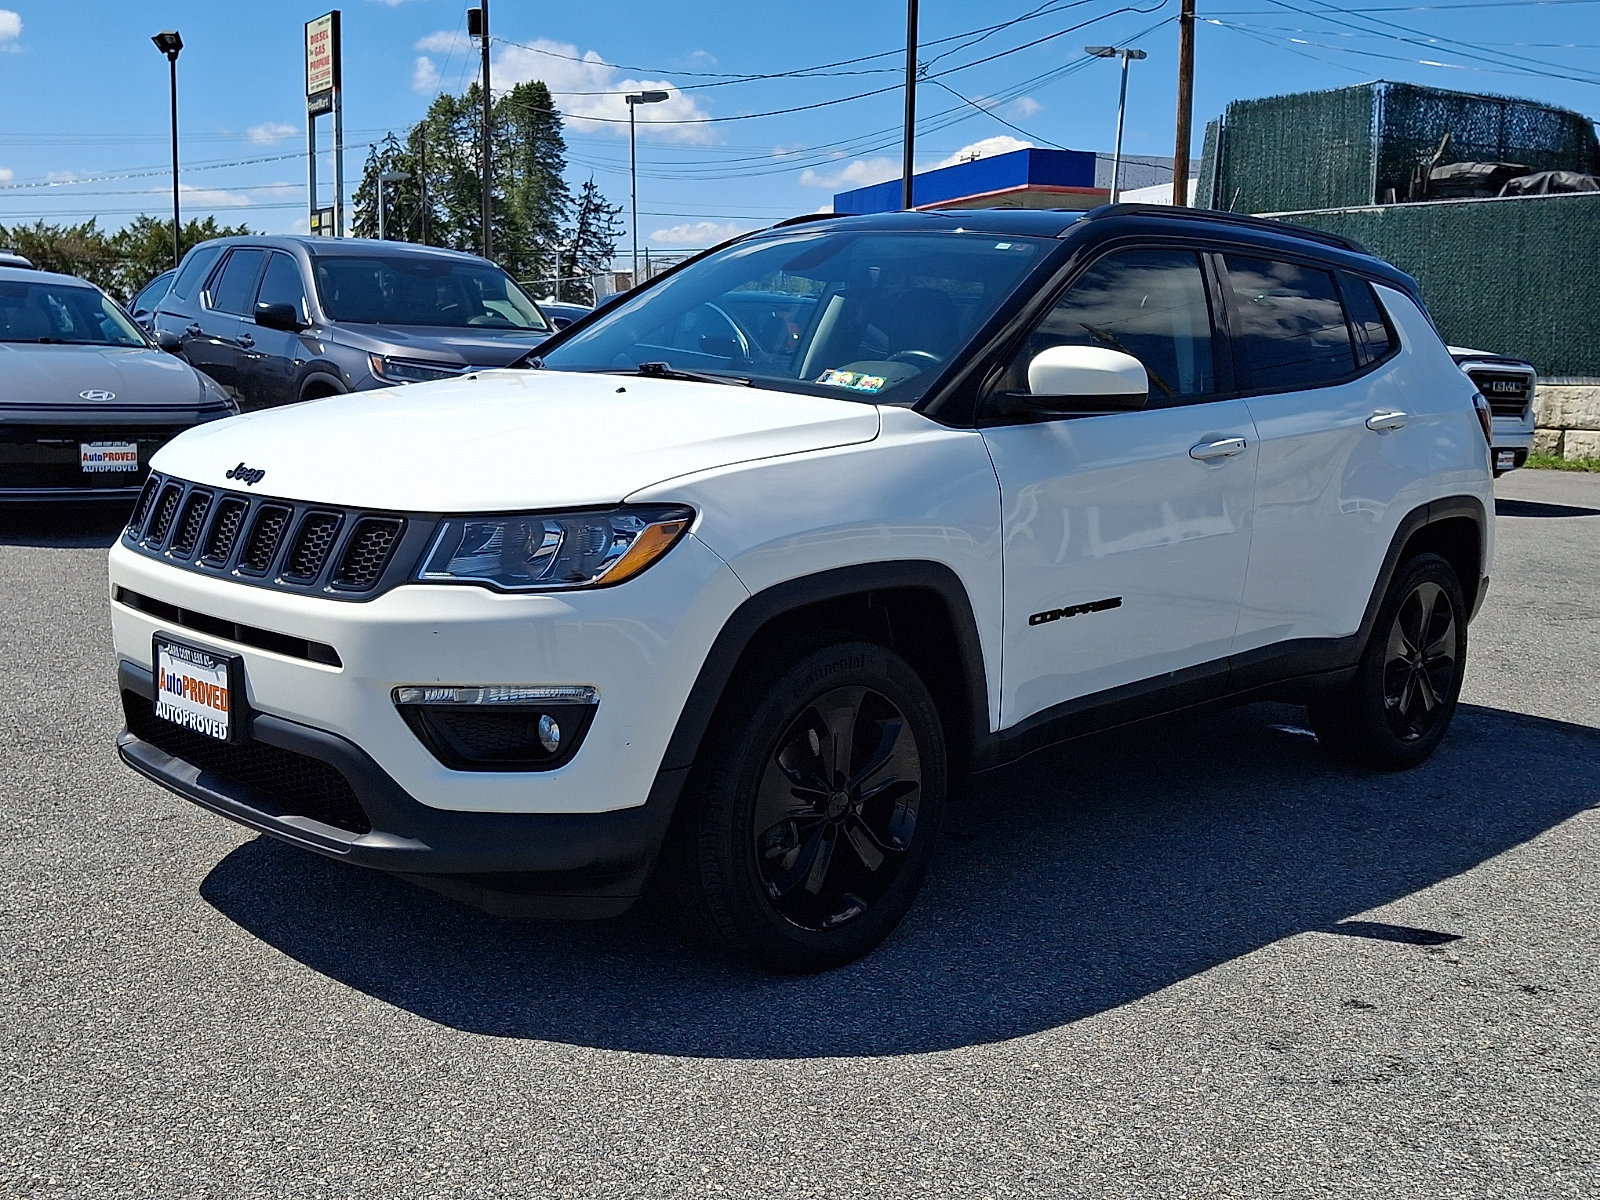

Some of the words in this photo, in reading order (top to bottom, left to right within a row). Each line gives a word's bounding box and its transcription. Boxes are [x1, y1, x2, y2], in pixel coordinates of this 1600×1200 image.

[314, 44, 326, 57] GAS
[83, 452, 136, 462] AutoPROVED
[226, 462, 265, 486] Jeep
[160, 667, 229, 712] AutoPROVED
[155, 701, 228, 740] AUTOPROVED
